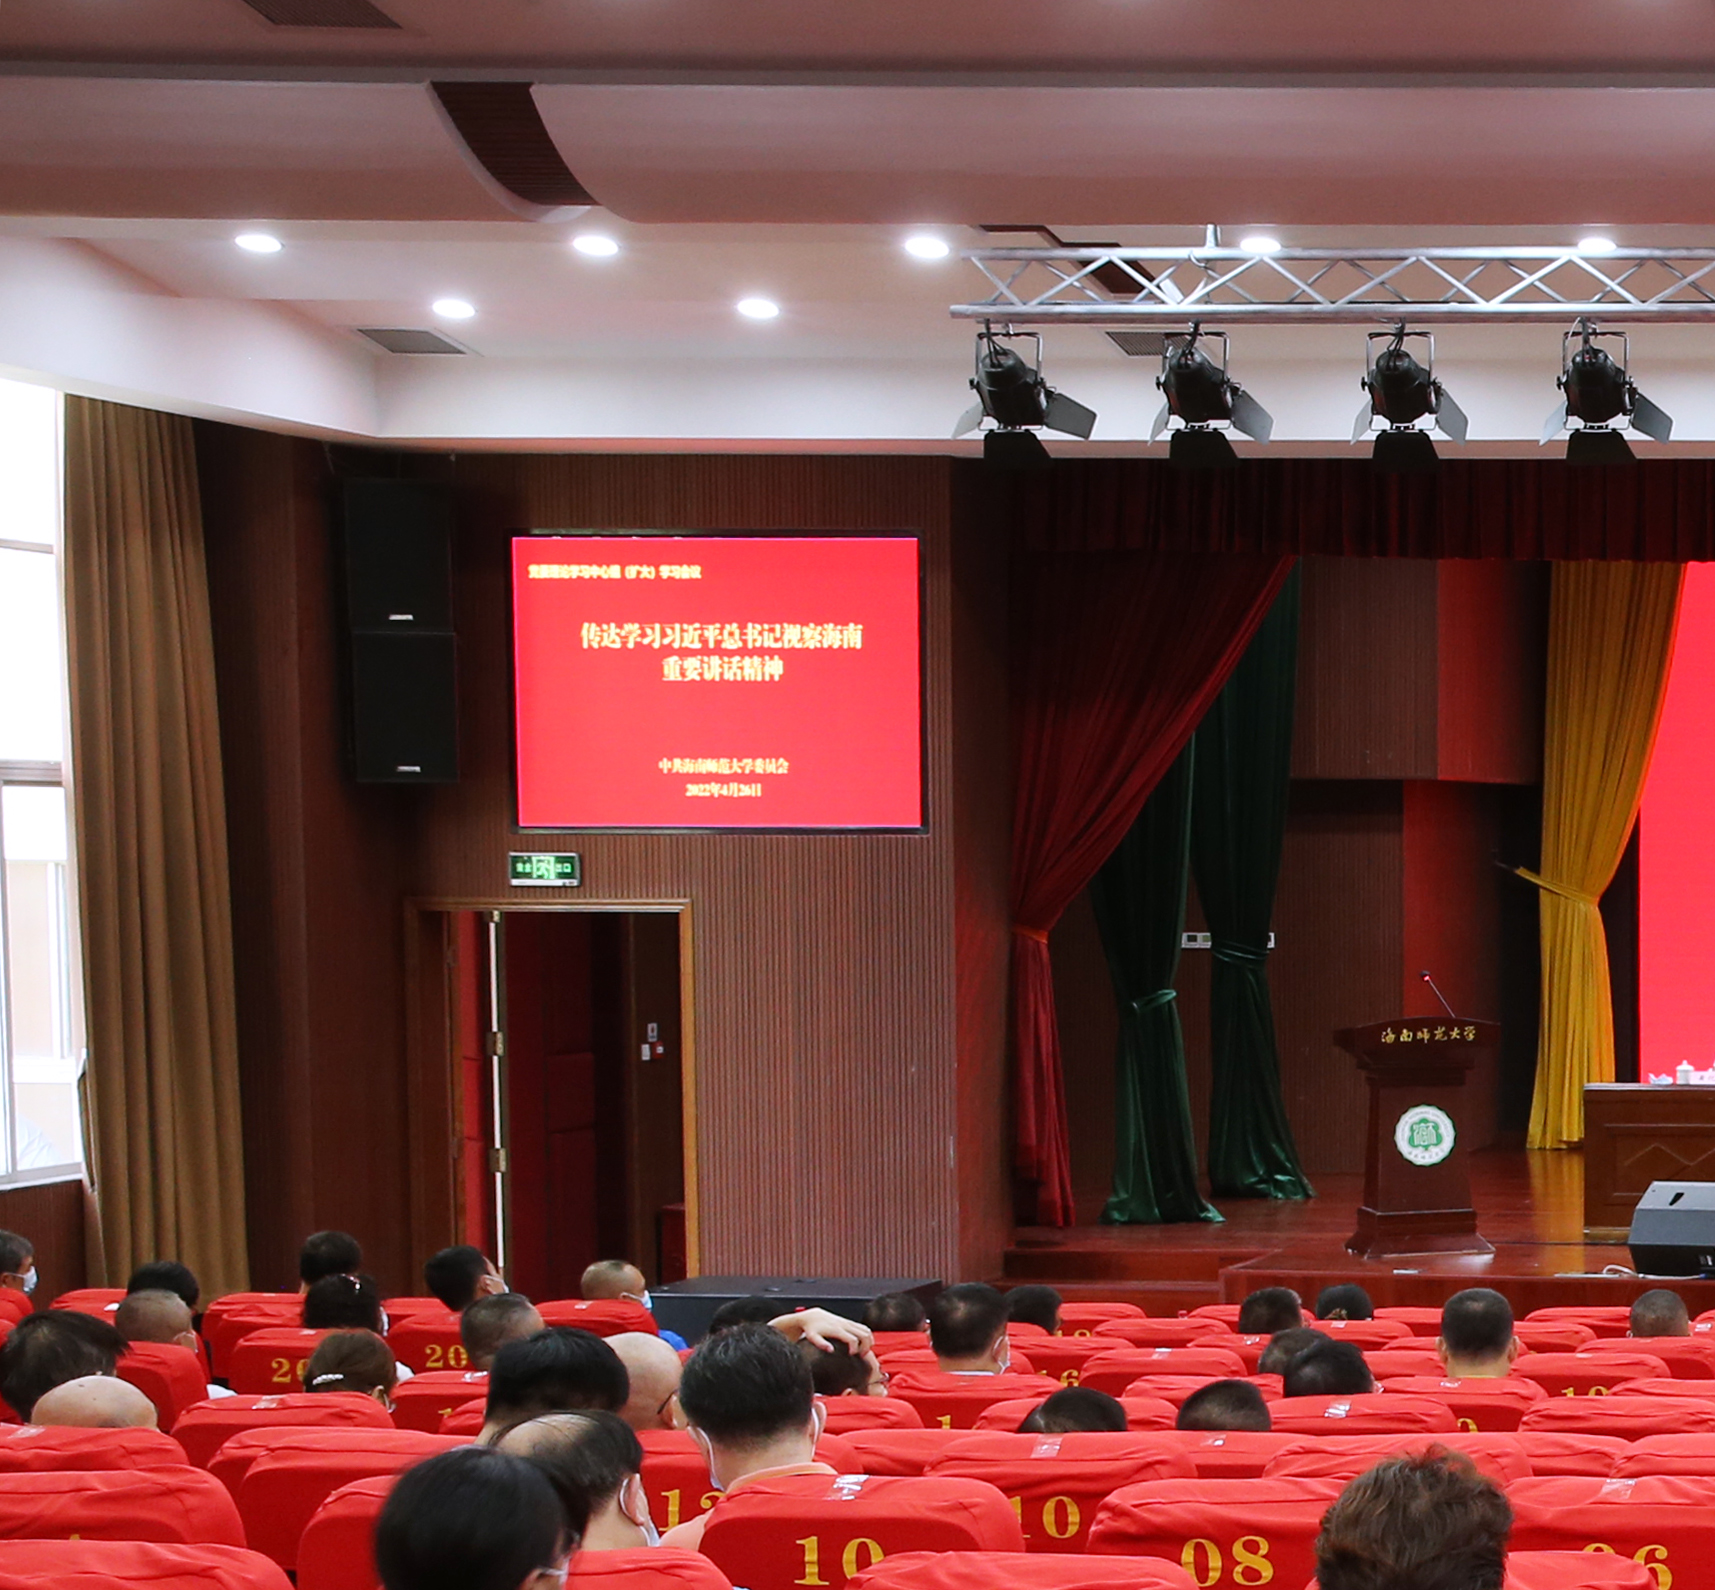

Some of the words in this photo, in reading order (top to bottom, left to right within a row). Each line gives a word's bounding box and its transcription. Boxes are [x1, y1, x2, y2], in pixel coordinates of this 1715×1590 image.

[580, 621, 864, 650] 传达学习习近平总书记视察海南
[661, 654, 784, 682] 重要讲话精神
[658, 757, 790, 775] 中共海南师范大学委员会
[684, 781, 763, 798] 2022年4月26日
[794, 1535, 886, 1586] 10
[1181, 1536, 1275, 1587] 08
